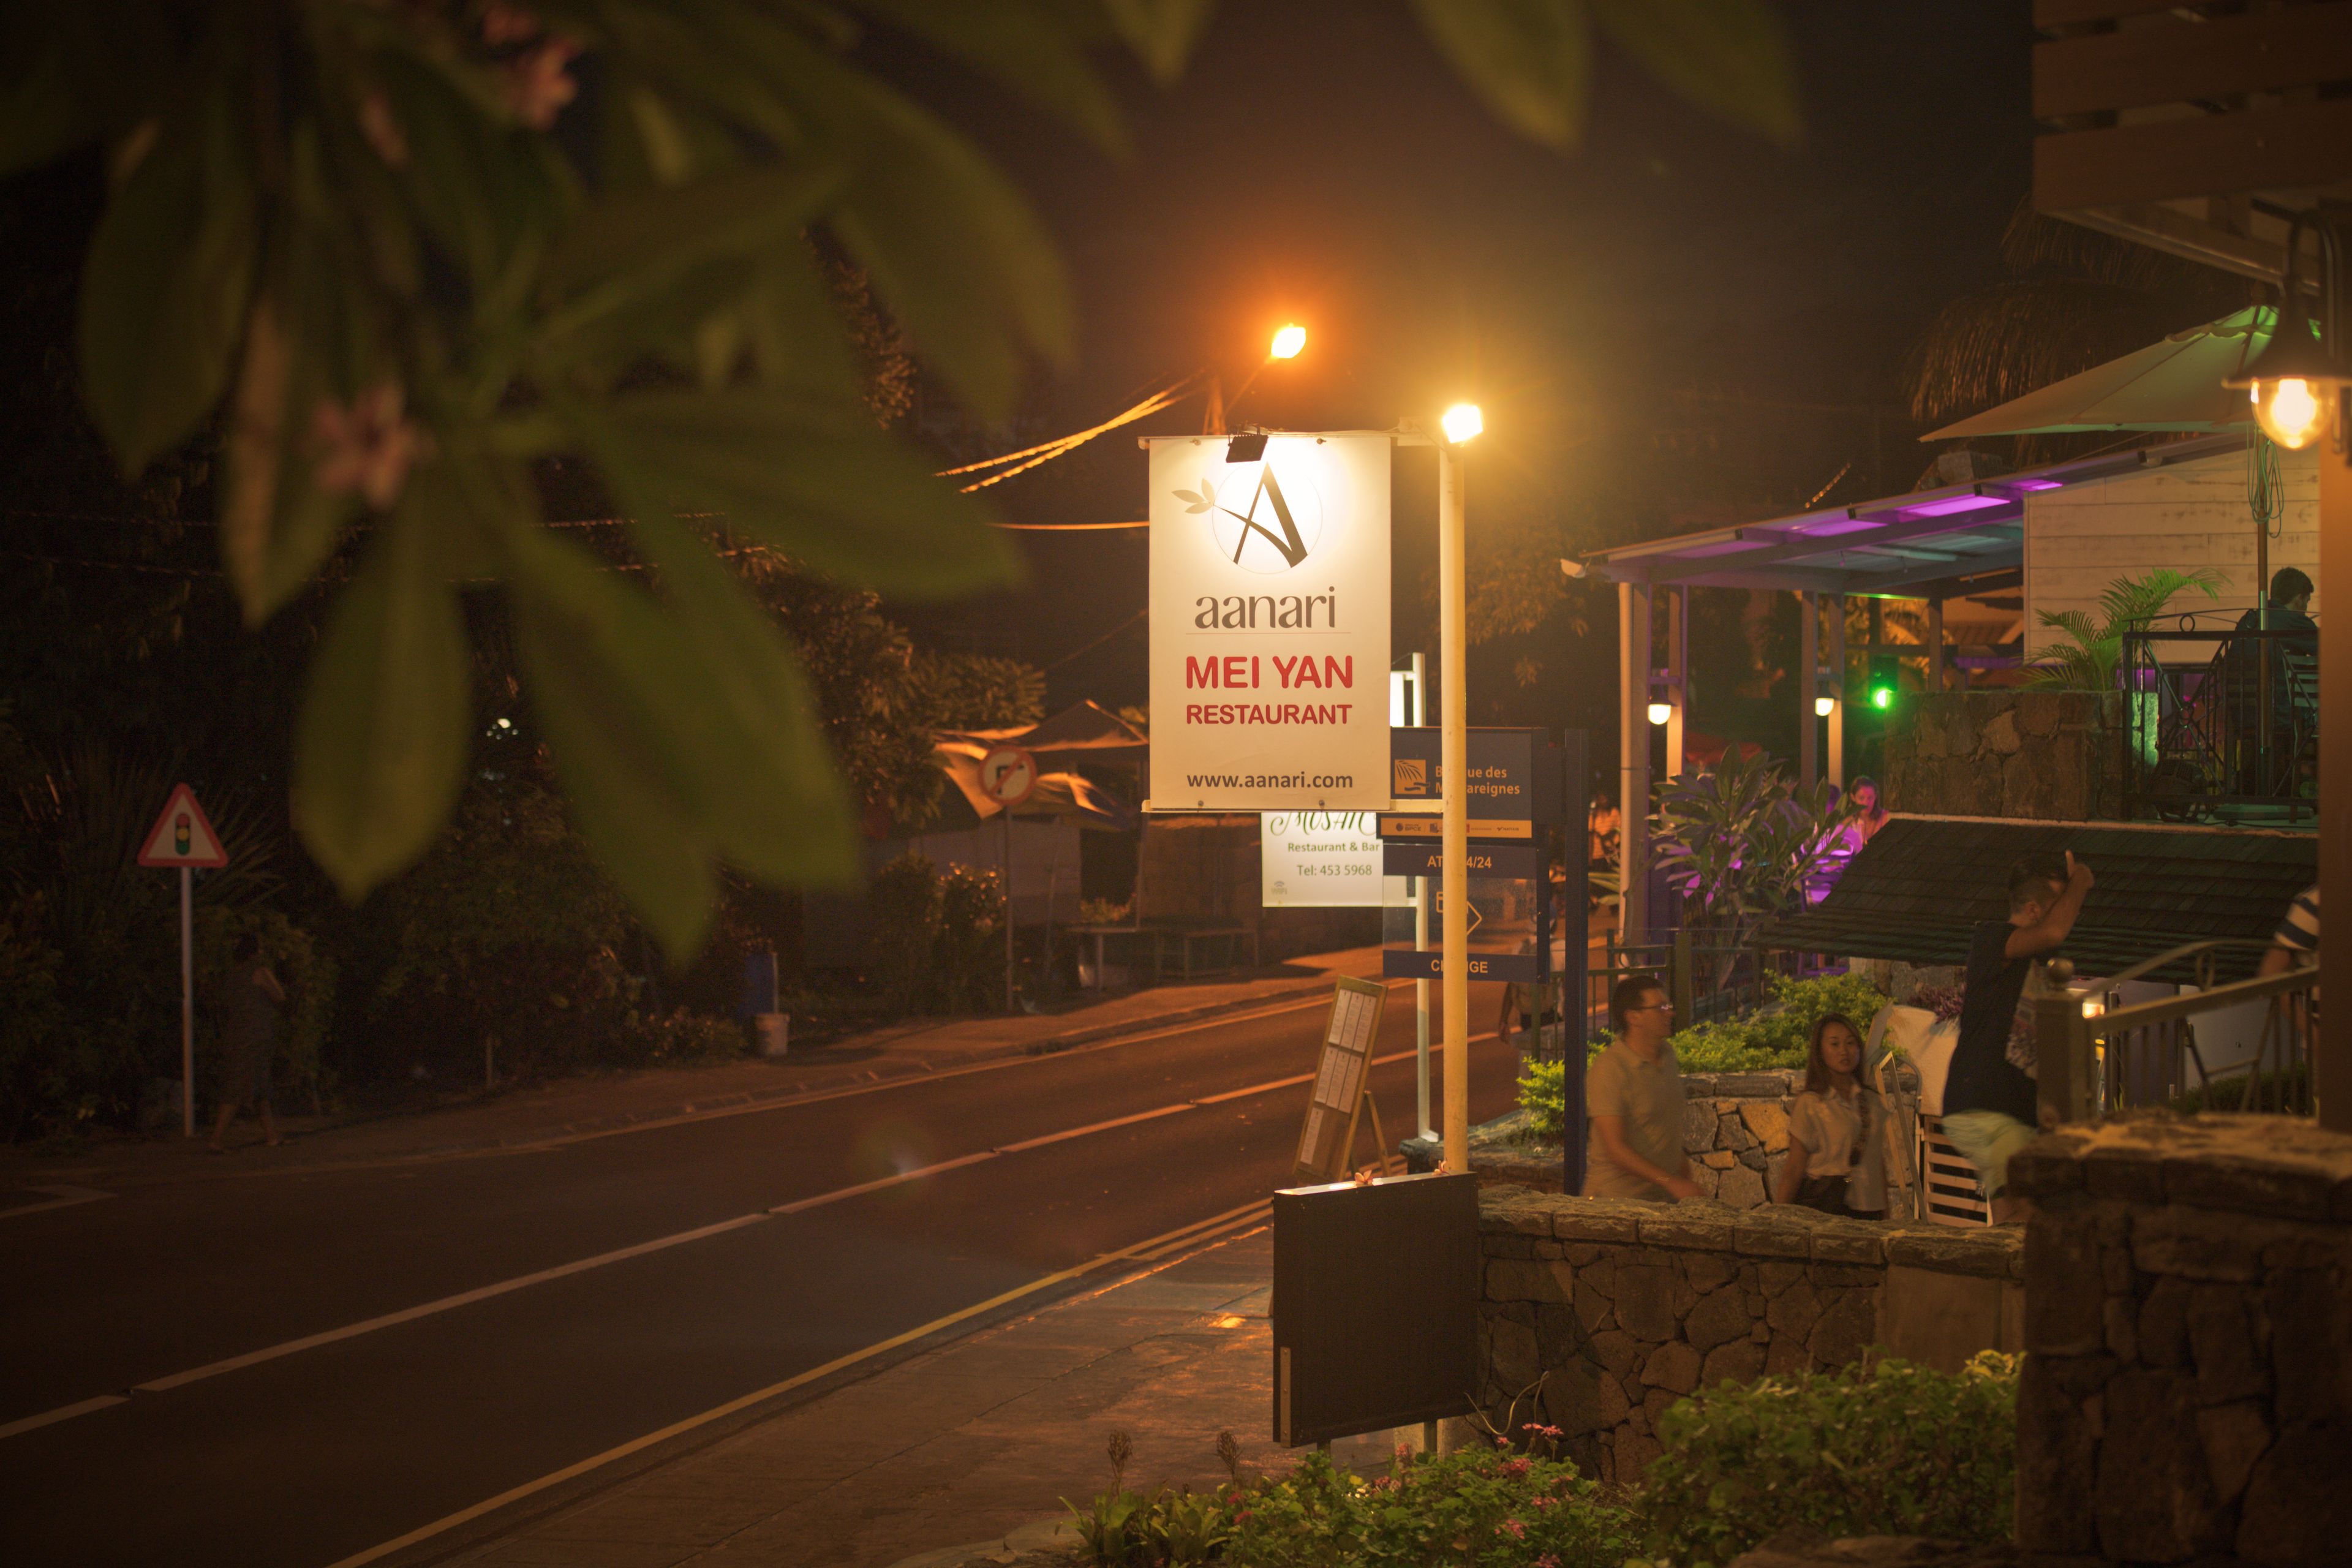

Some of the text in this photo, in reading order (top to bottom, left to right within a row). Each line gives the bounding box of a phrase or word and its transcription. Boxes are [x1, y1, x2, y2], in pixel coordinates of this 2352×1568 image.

[1194, 586, 1336, 630] aanari
[1186, 655, 1353, 689] MEI YAN
[1186, 704, 1353, 725] RESTAURANT
[1435, 766, 1507, 778] Bue des
[1186, 771, 1354, 789] www.aanari.com
[1435, 782, 1520, 797] Mareignes
[1287, 842, 1380, 852] Restaurant & Bar
[1297, 864, 1373, 876] Tel: 453 5968
[1427, 856, 1492, 869] AT 4/24
